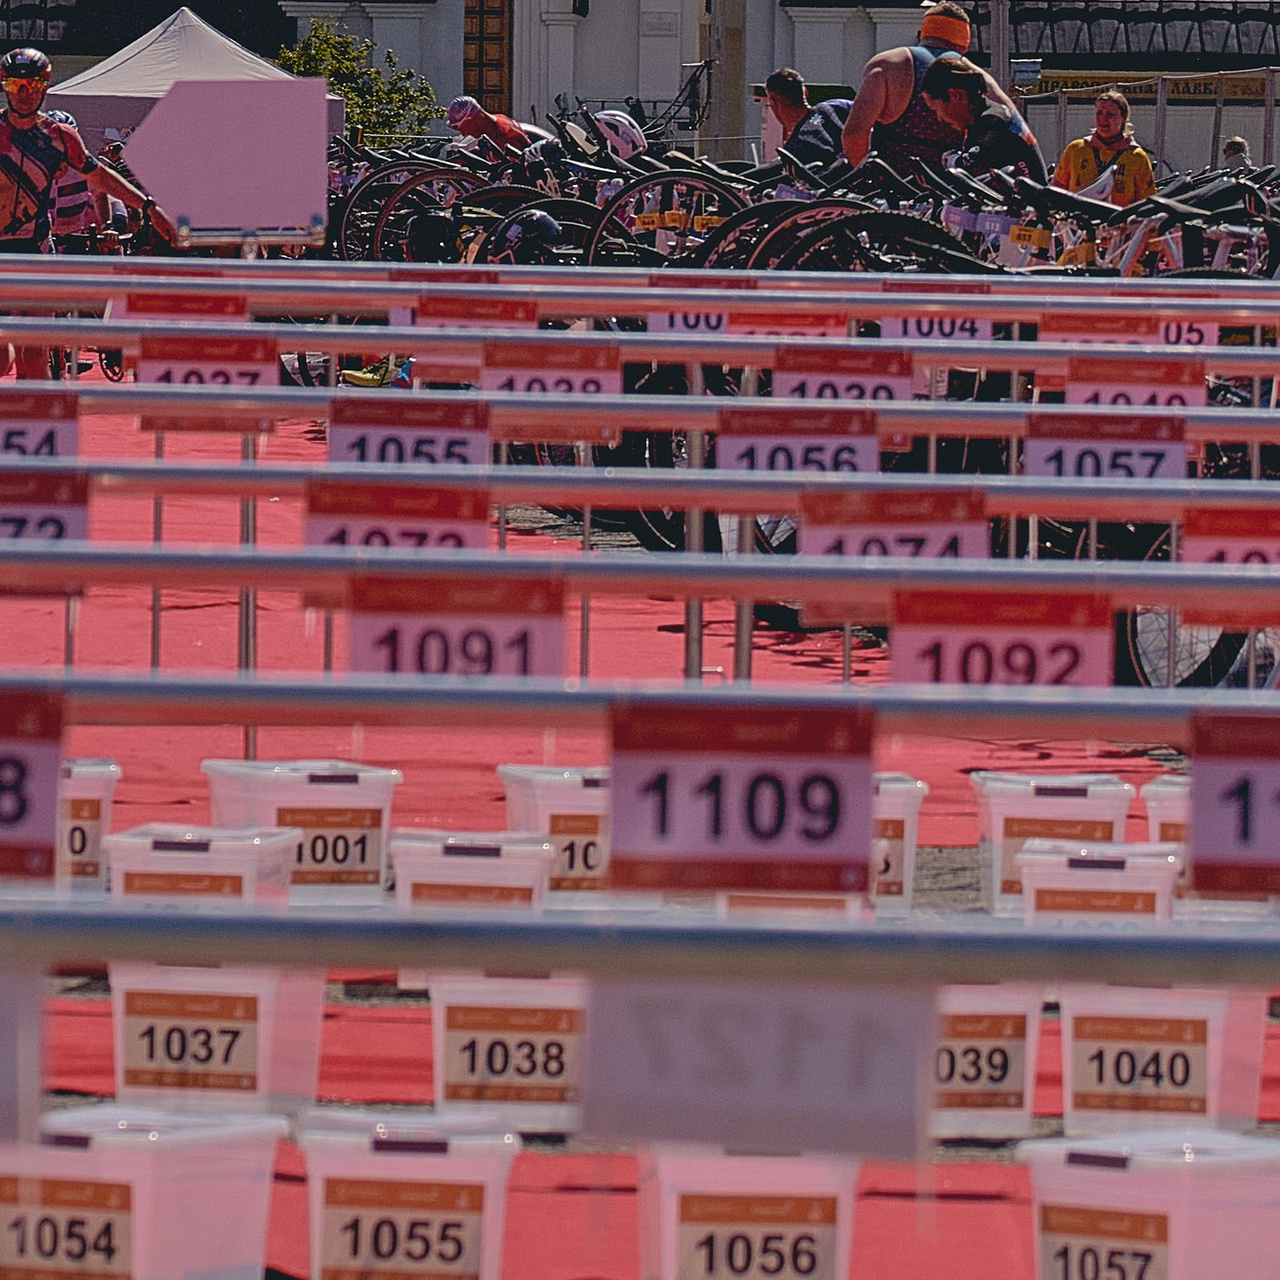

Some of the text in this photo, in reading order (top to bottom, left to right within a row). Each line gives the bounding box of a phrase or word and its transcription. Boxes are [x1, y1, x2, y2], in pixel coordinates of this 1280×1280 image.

[900, 317, 978, 338] 1004
[348, 436, 468, 463] 1055
[736, 444, 858, 471] 1056
[1044, 449, 1166, 477] 1057
[372, 628, 531, 674] 1091
[917, 641, 1081, 683] 1092
[641, 768, 840, 842] 1109
[138, 1025, 241, 1065] 1037
[460, 1039, 566, 1078] 1038
[1088, 1048, 1191, 1087] 1040
[8, 1215, 117, 1261] 1054
[341, 1217, 465, 1262] 1055
[695, 1233, 818, 1276] 1056
[1054, 1245, 1153, 1280] 1057
